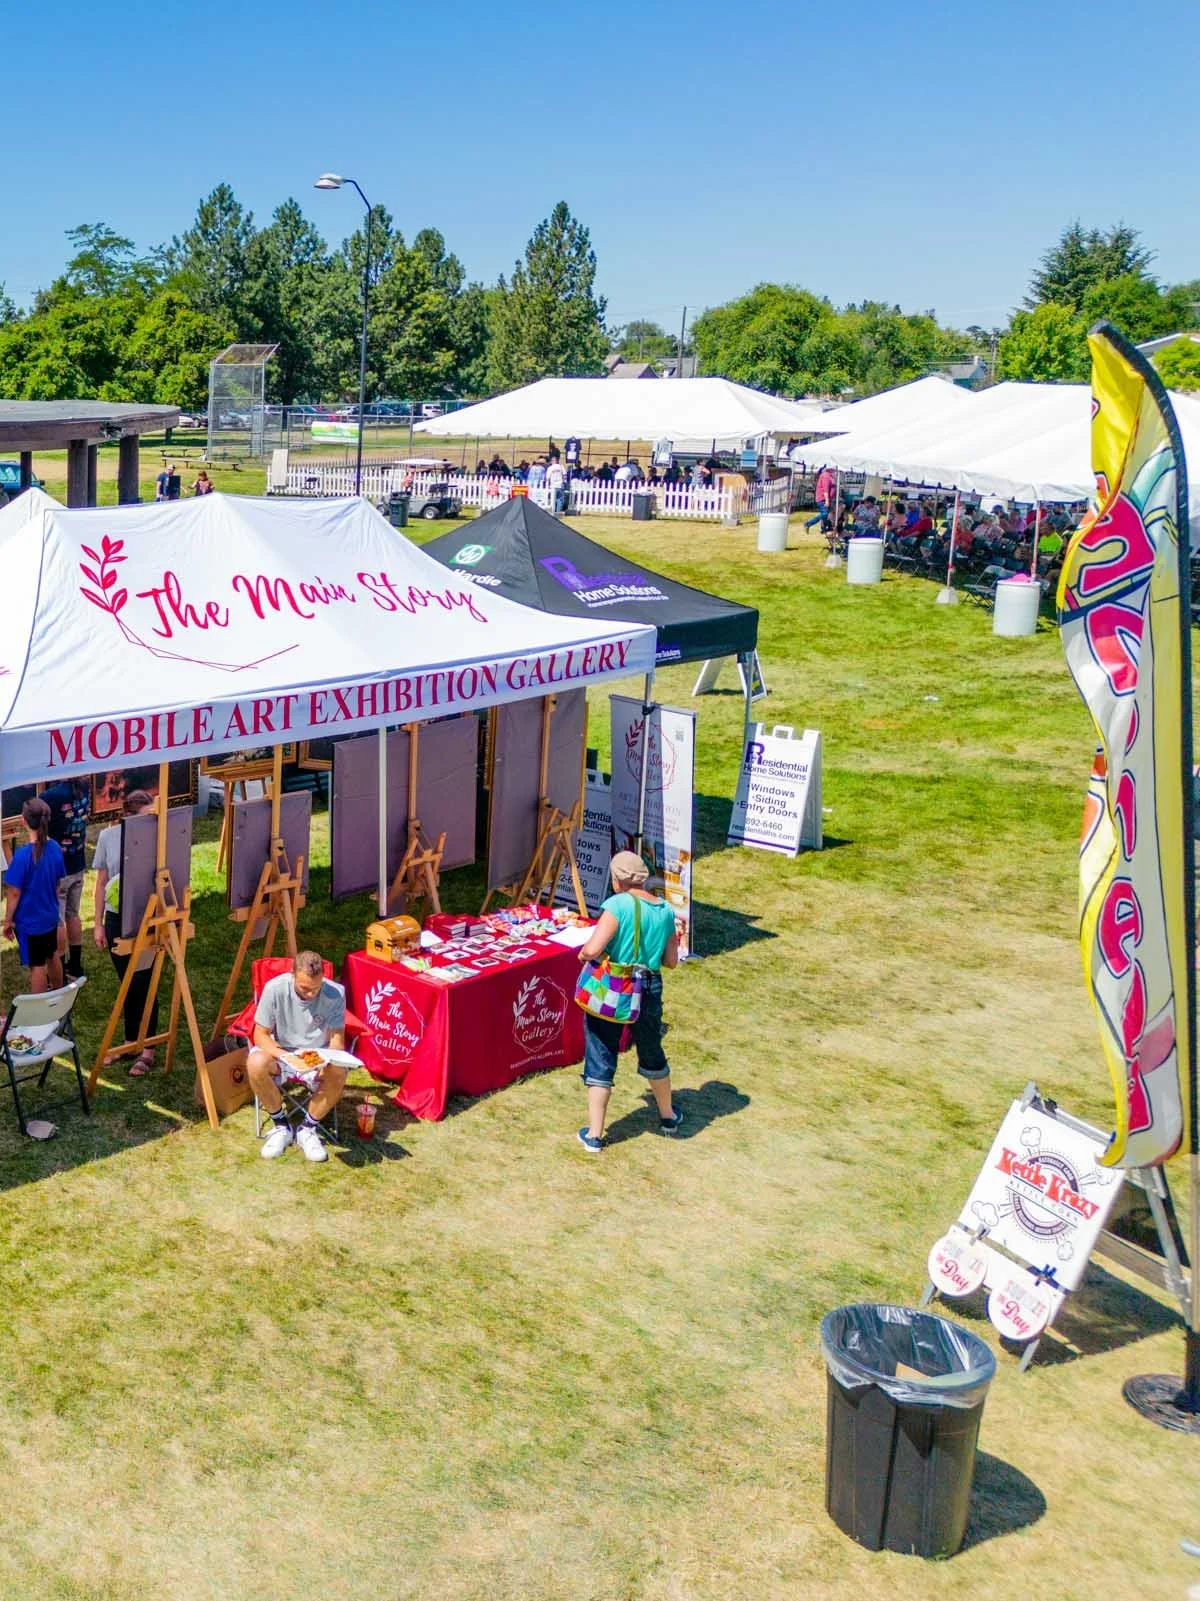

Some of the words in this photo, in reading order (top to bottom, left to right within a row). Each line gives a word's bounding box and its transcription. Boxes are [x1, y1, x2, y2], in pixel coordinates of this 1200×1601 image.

[135, 571, 229, 638] The
[232, 575, 355, 619] Main
[357, 572, 488, 623] Story
[572, 586, 616, 603] Home
[48, 705, 214, 768] MOBILE
[223, 694, 299, 740] ART
[307, 663, 498, 726] EXHIBITION
[504, 638, 634, 688] GALLERY
[745, 741, 808, 773] Residential
[743, 764, 767, 775] Home
[768, 767, 807, 781] Solutions
[768, 805, 798, 819] Doors
[387, 1001, 404, 1019] The
[537, 1007, 563, 1025] Story
[368, 1012, 391, 1032] Main
[393, 1021, 420, 1049] Story
[522, 1026, 555, 1042] Gallery
[375, 1033, 413, 1057] Gallery
[995, 1146, 1047, 1190] Kettle
[1045, 1172, 1100, 1221] Krazy
[940, 1259, 969, 1292] Day
